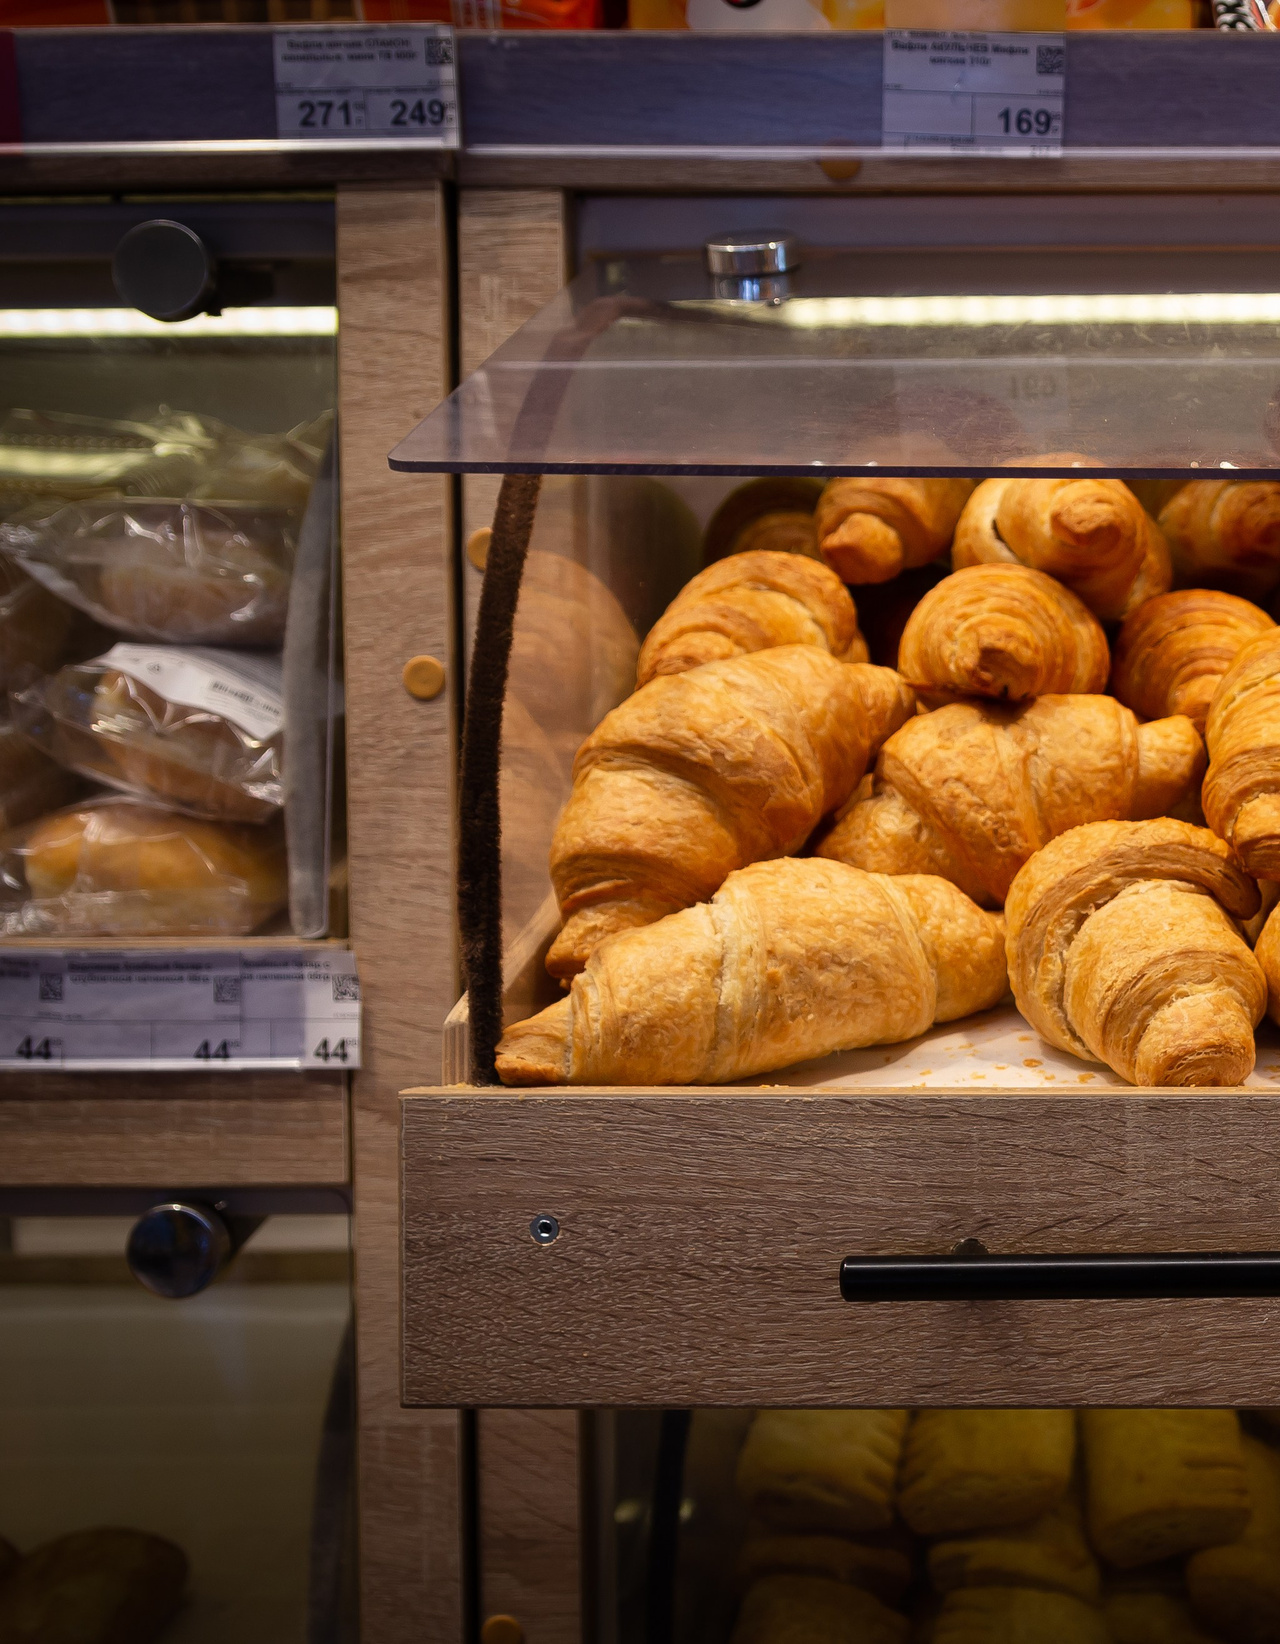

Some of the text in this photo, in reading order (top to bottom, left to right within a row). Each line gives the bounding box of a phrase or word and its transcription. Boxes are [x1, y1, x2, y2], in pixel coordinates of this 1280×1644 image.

[299, 100, 350, 127] 271
[389, 100, 444, 127] 249
[998, 106, 1051, 135] 169
[16, 1035, 51, 1060] 44
[193, 1038, 230, 1060] 44
[313, 1037, 348, 1062] 44
